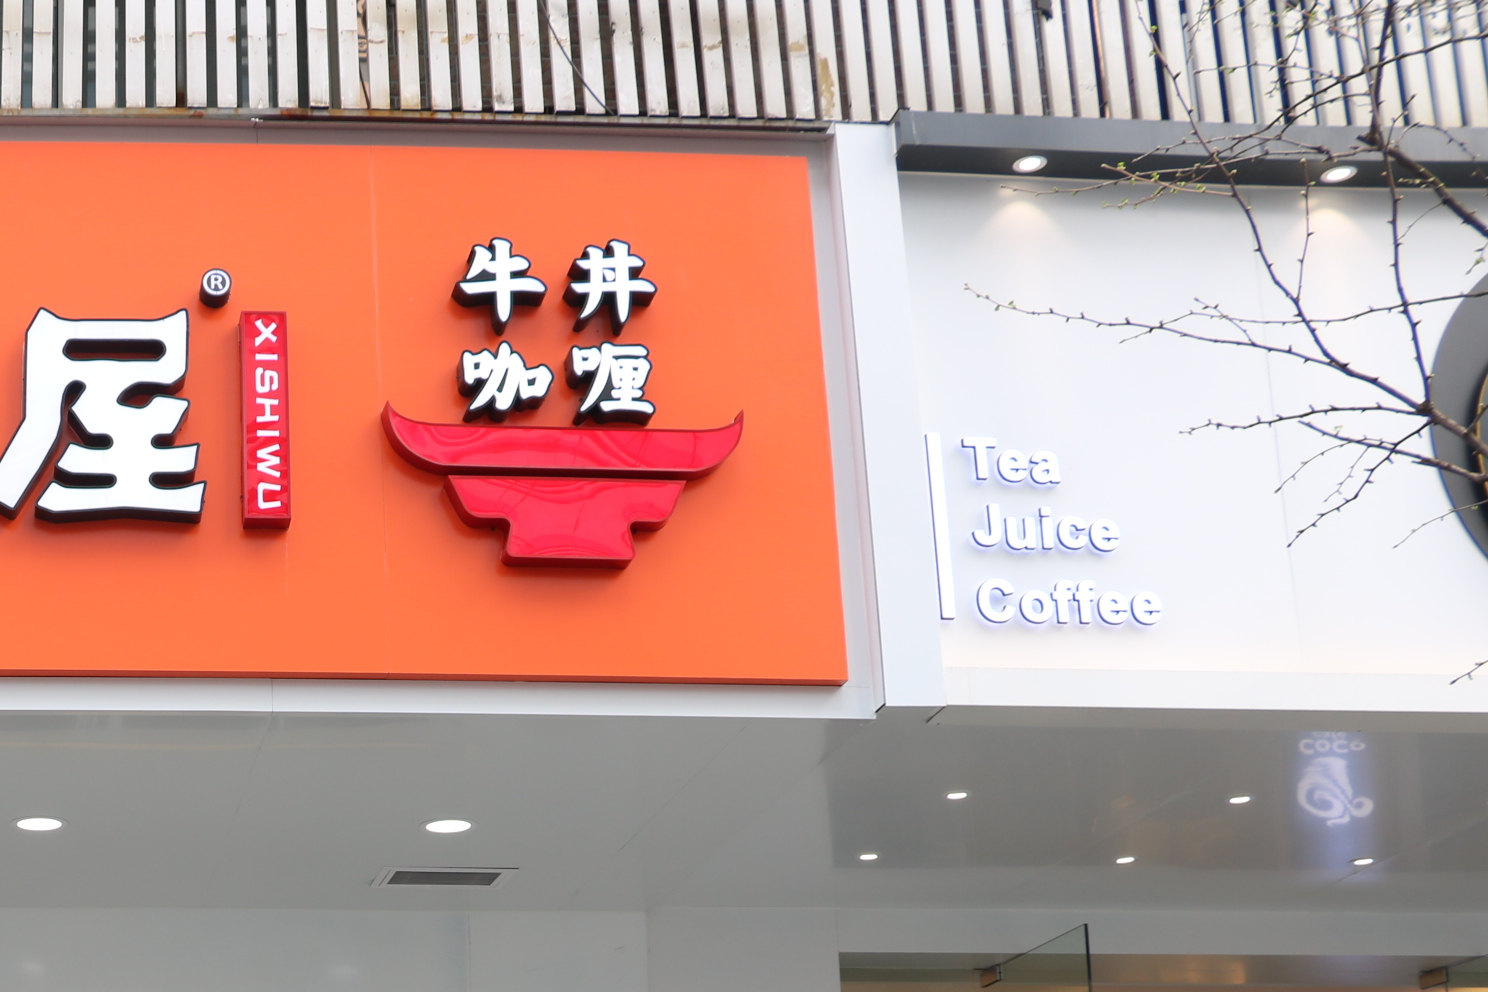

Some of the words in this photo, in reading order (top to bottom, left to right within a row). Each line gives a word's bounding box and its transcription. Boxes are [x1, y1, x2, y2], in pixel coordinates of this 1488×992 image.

[456, 340, 654, 425] 咖喱
[254, 317, 283, 510] XISHIWU
[961, 436, 1062, 485] Tea
[971, 503, 1121, 553] Juice
[976, 577, 1163, 626] Coffee
